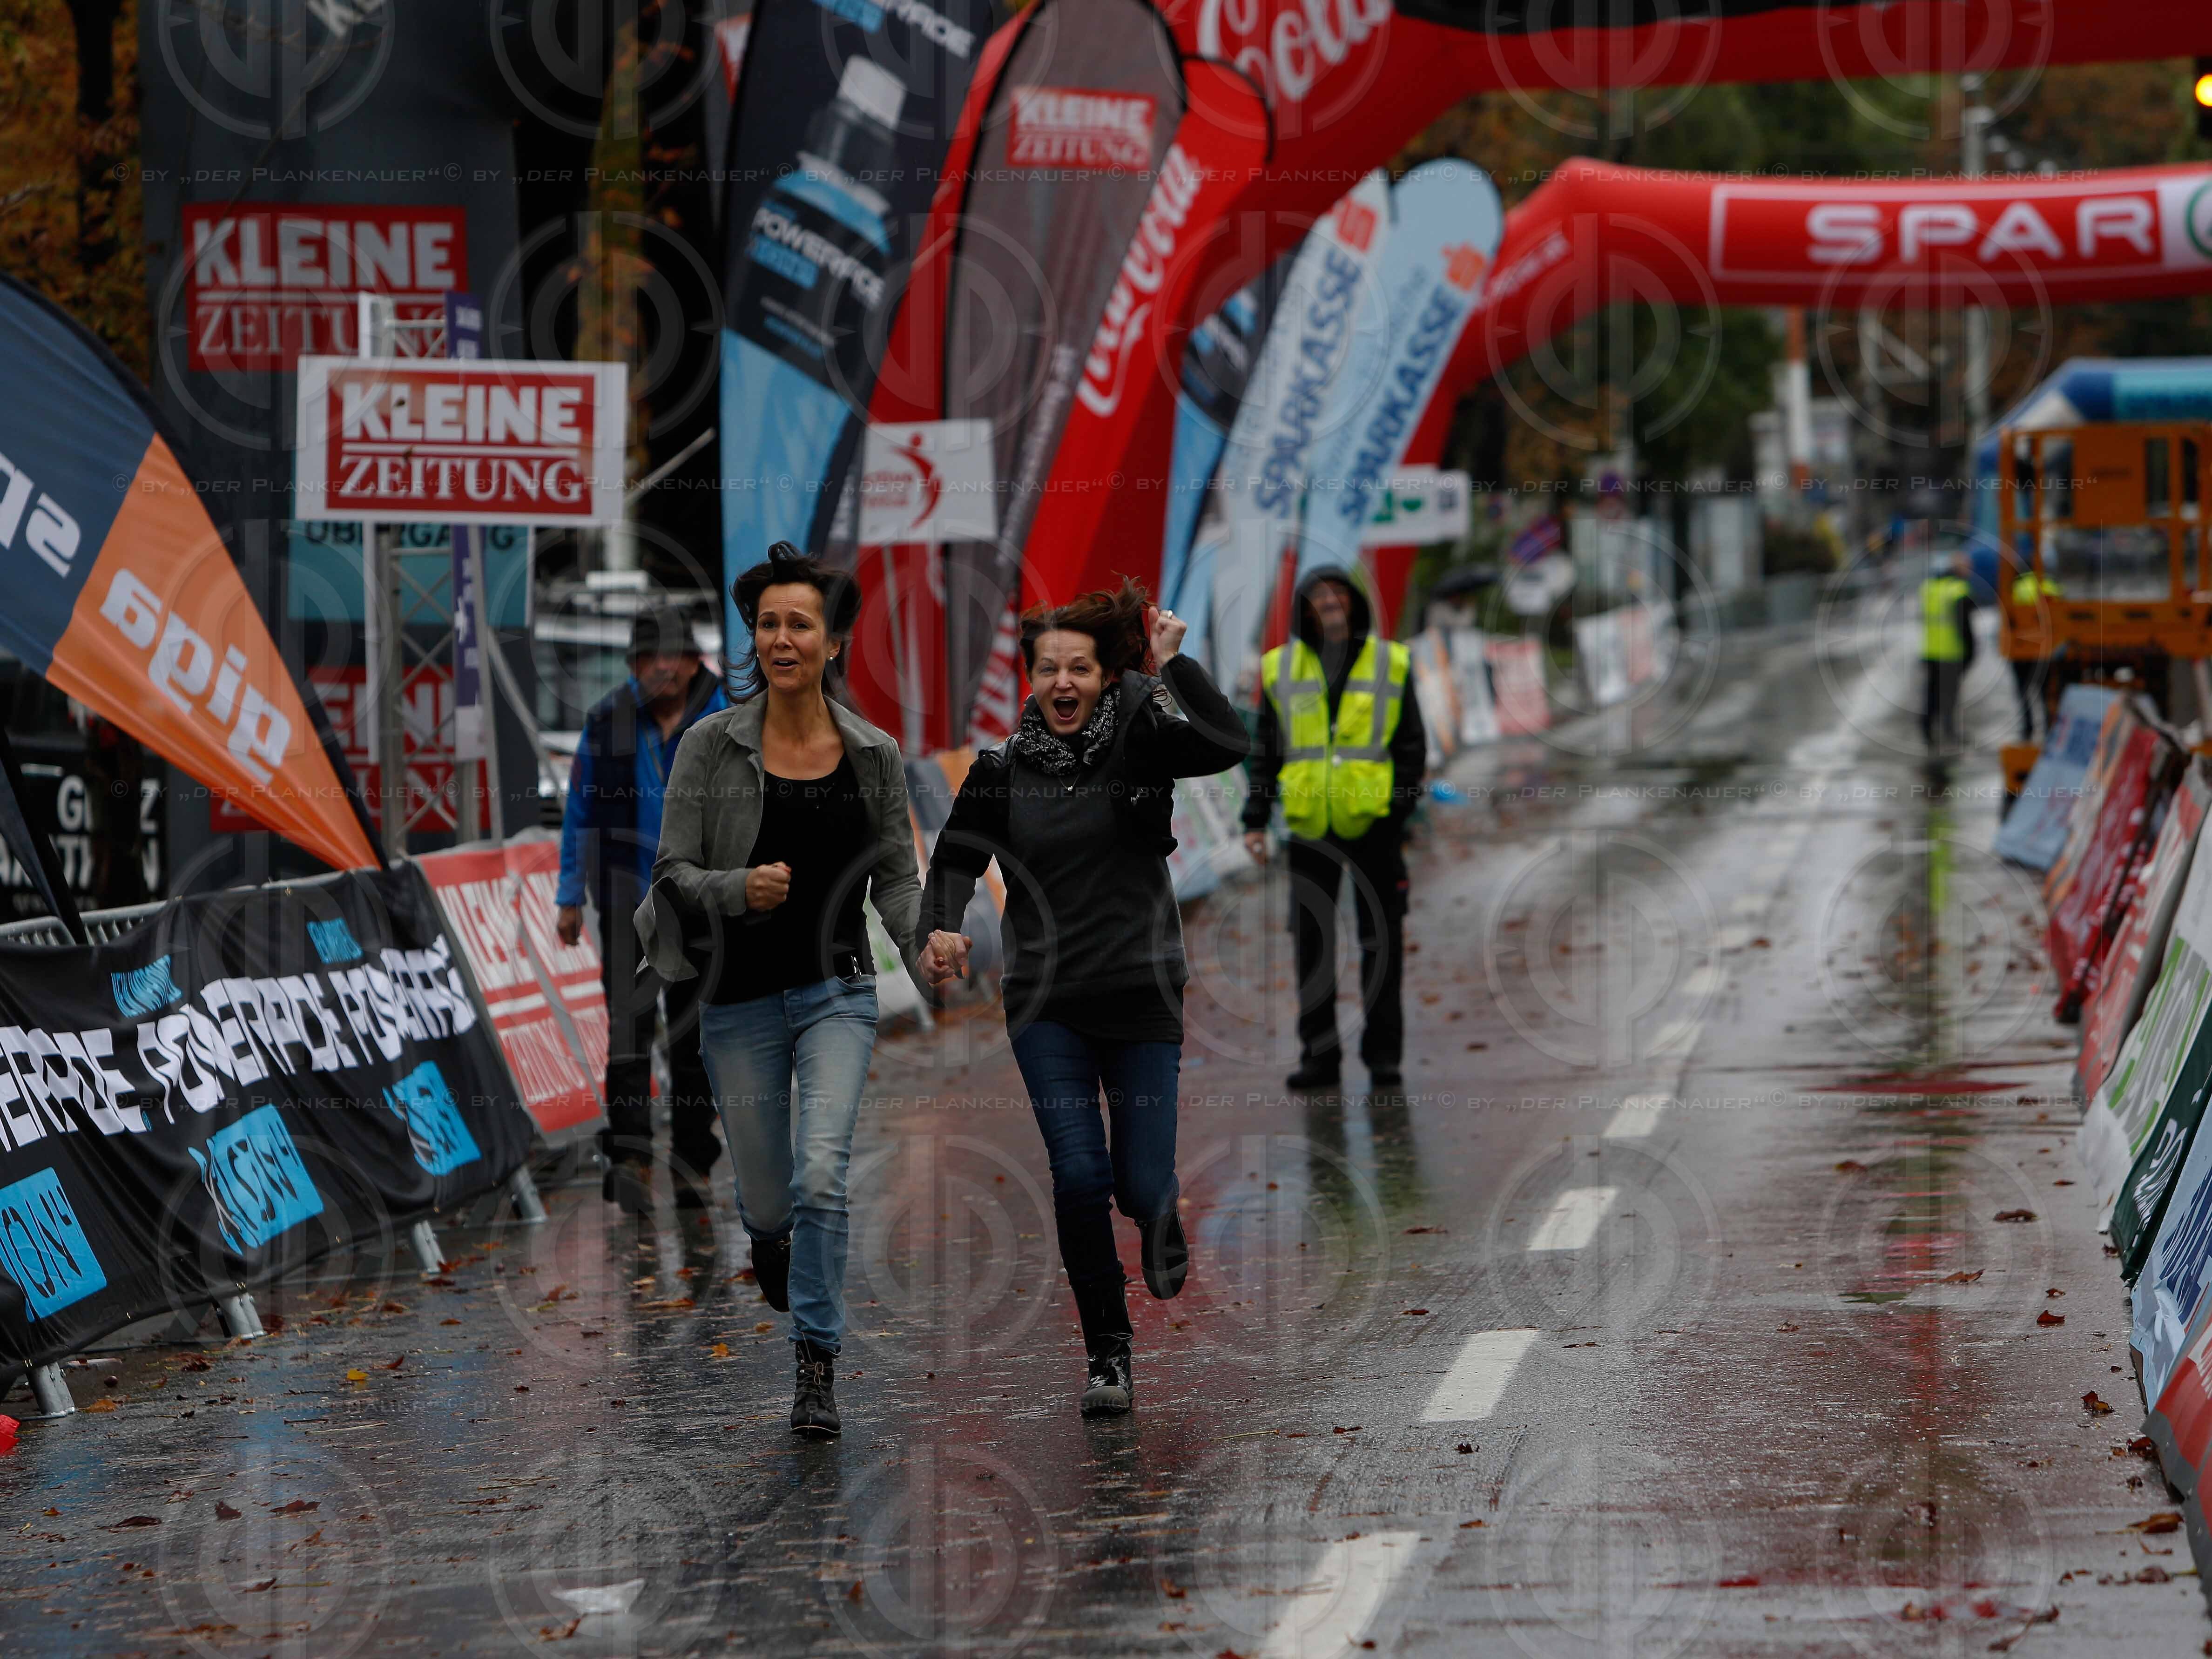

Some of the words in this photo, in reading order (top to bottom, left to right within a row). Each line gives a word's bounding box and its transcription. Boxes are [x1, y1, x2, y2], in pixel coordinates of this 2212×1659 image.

[1015, 92, 1151, 133] KLEINE
[1012, 131, 1151, 167] ZEITUNG
[192, 218, 457, 289] KLEINE
[1806, 196, 2154, 264] SPAR
[341, 382, 582, 444] KLEINE
[1254, 247, 1365, 518] SPARKASSE
[1335, 282, 1463, 526] SPARKASSE
[338, 453, 582, 504] ZEITUNG
[0, 1024, 148, 1153] ERADE
[136, 973, 359, 1125] POWERADE
